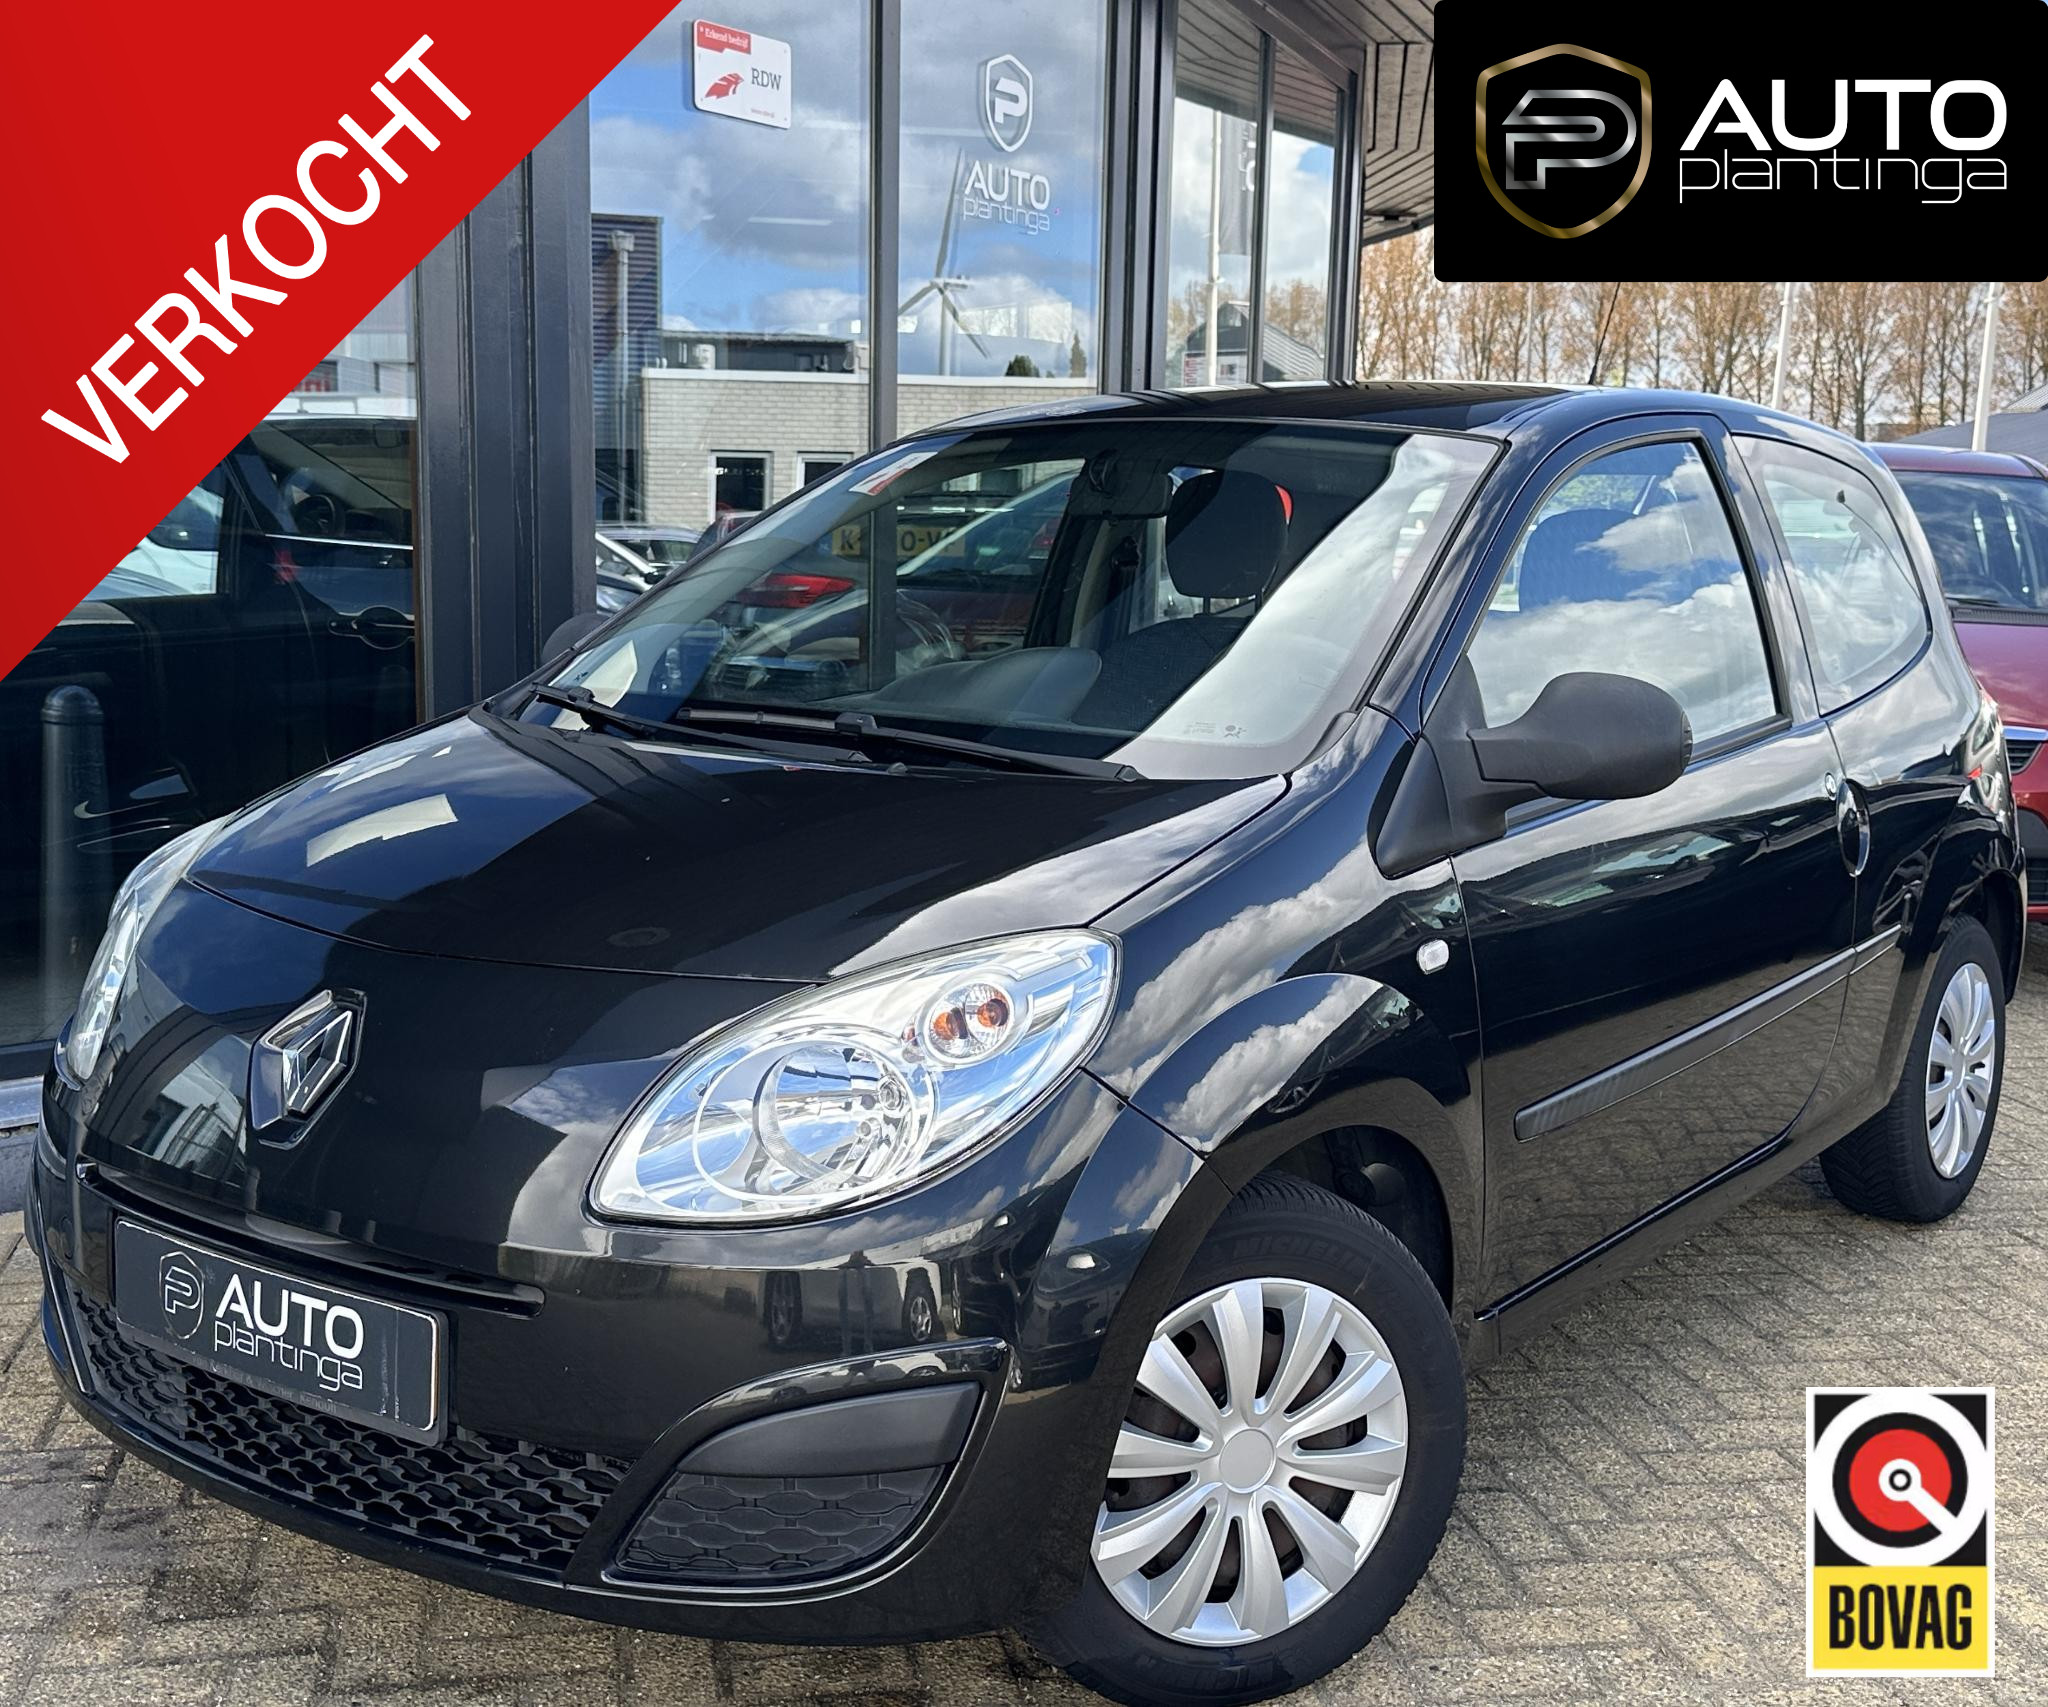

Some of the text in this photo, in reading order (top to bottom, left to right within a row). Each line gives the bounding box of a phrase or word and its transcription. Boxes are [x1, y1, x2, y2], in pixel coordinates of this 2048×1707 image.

[751, 67, 782, 91] RDW
[965, 160, 1050, 211] AUTO
[963, 196, 1050, 236] plantinga
[215, 1274, 364, 1359] AUTO
[214, 1319, 363, 1392] plantinga
